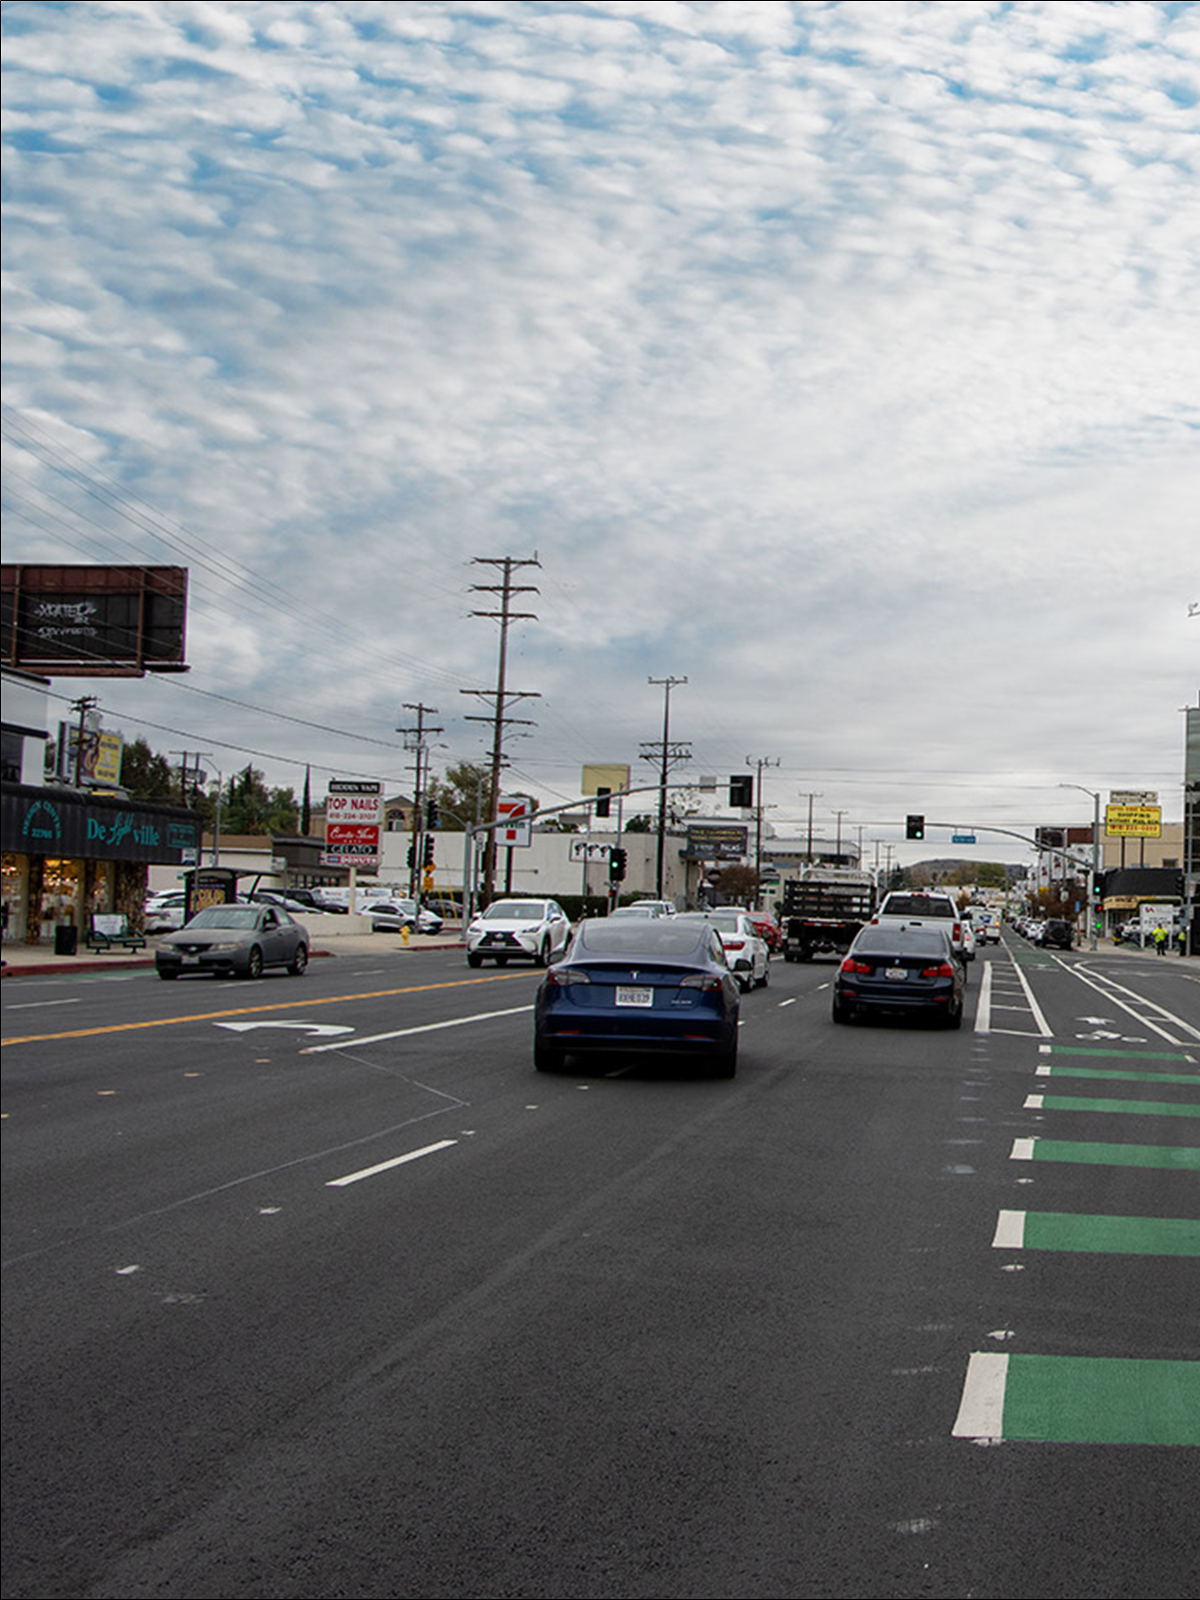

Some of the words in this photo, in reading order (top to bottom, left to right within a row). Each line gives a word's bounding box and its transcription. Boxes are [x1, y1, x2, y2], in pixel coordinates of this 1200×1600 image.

[328, 798, 347, 810] TOP
[351, 798, 379, 811] NAILS
[87, 818, 107, 841] De
[133, 825, 160, 846] ville
[331, 844, 373, 854] GELATO
